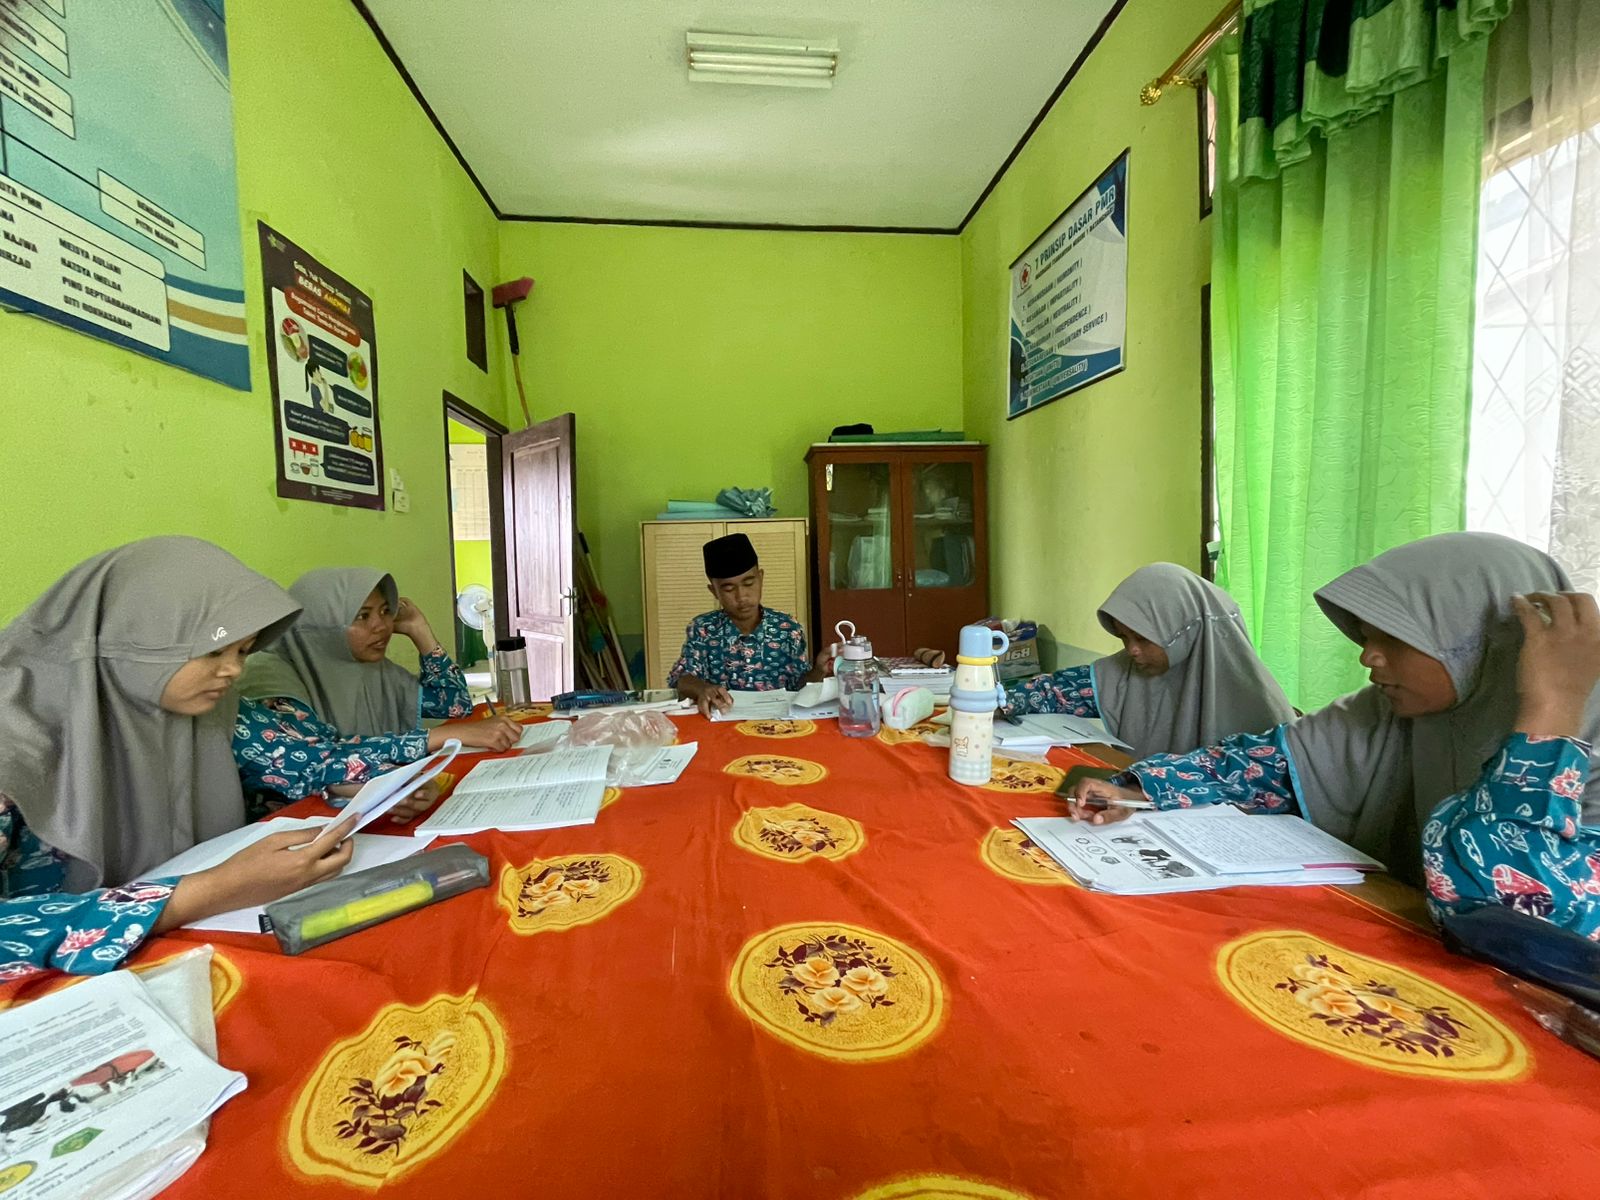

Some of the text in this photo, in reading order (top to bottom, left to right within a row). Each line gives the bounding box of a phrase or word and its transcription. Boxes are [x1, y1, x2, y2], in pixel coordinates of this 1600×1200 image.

[1040, 233, 1066, 265] PRINSIP
[1068, 208, 1093, 240] DASAR
[1095, 187, 1115, 215] PMR
[298, 276, 322, 297] BEBAS
[1055, 306, 1088, 335] INDEPENDENCE
[1057, 328, 1082, 349] VOLUNTARY
[1083, 313, 1104, 335] SERVICE
